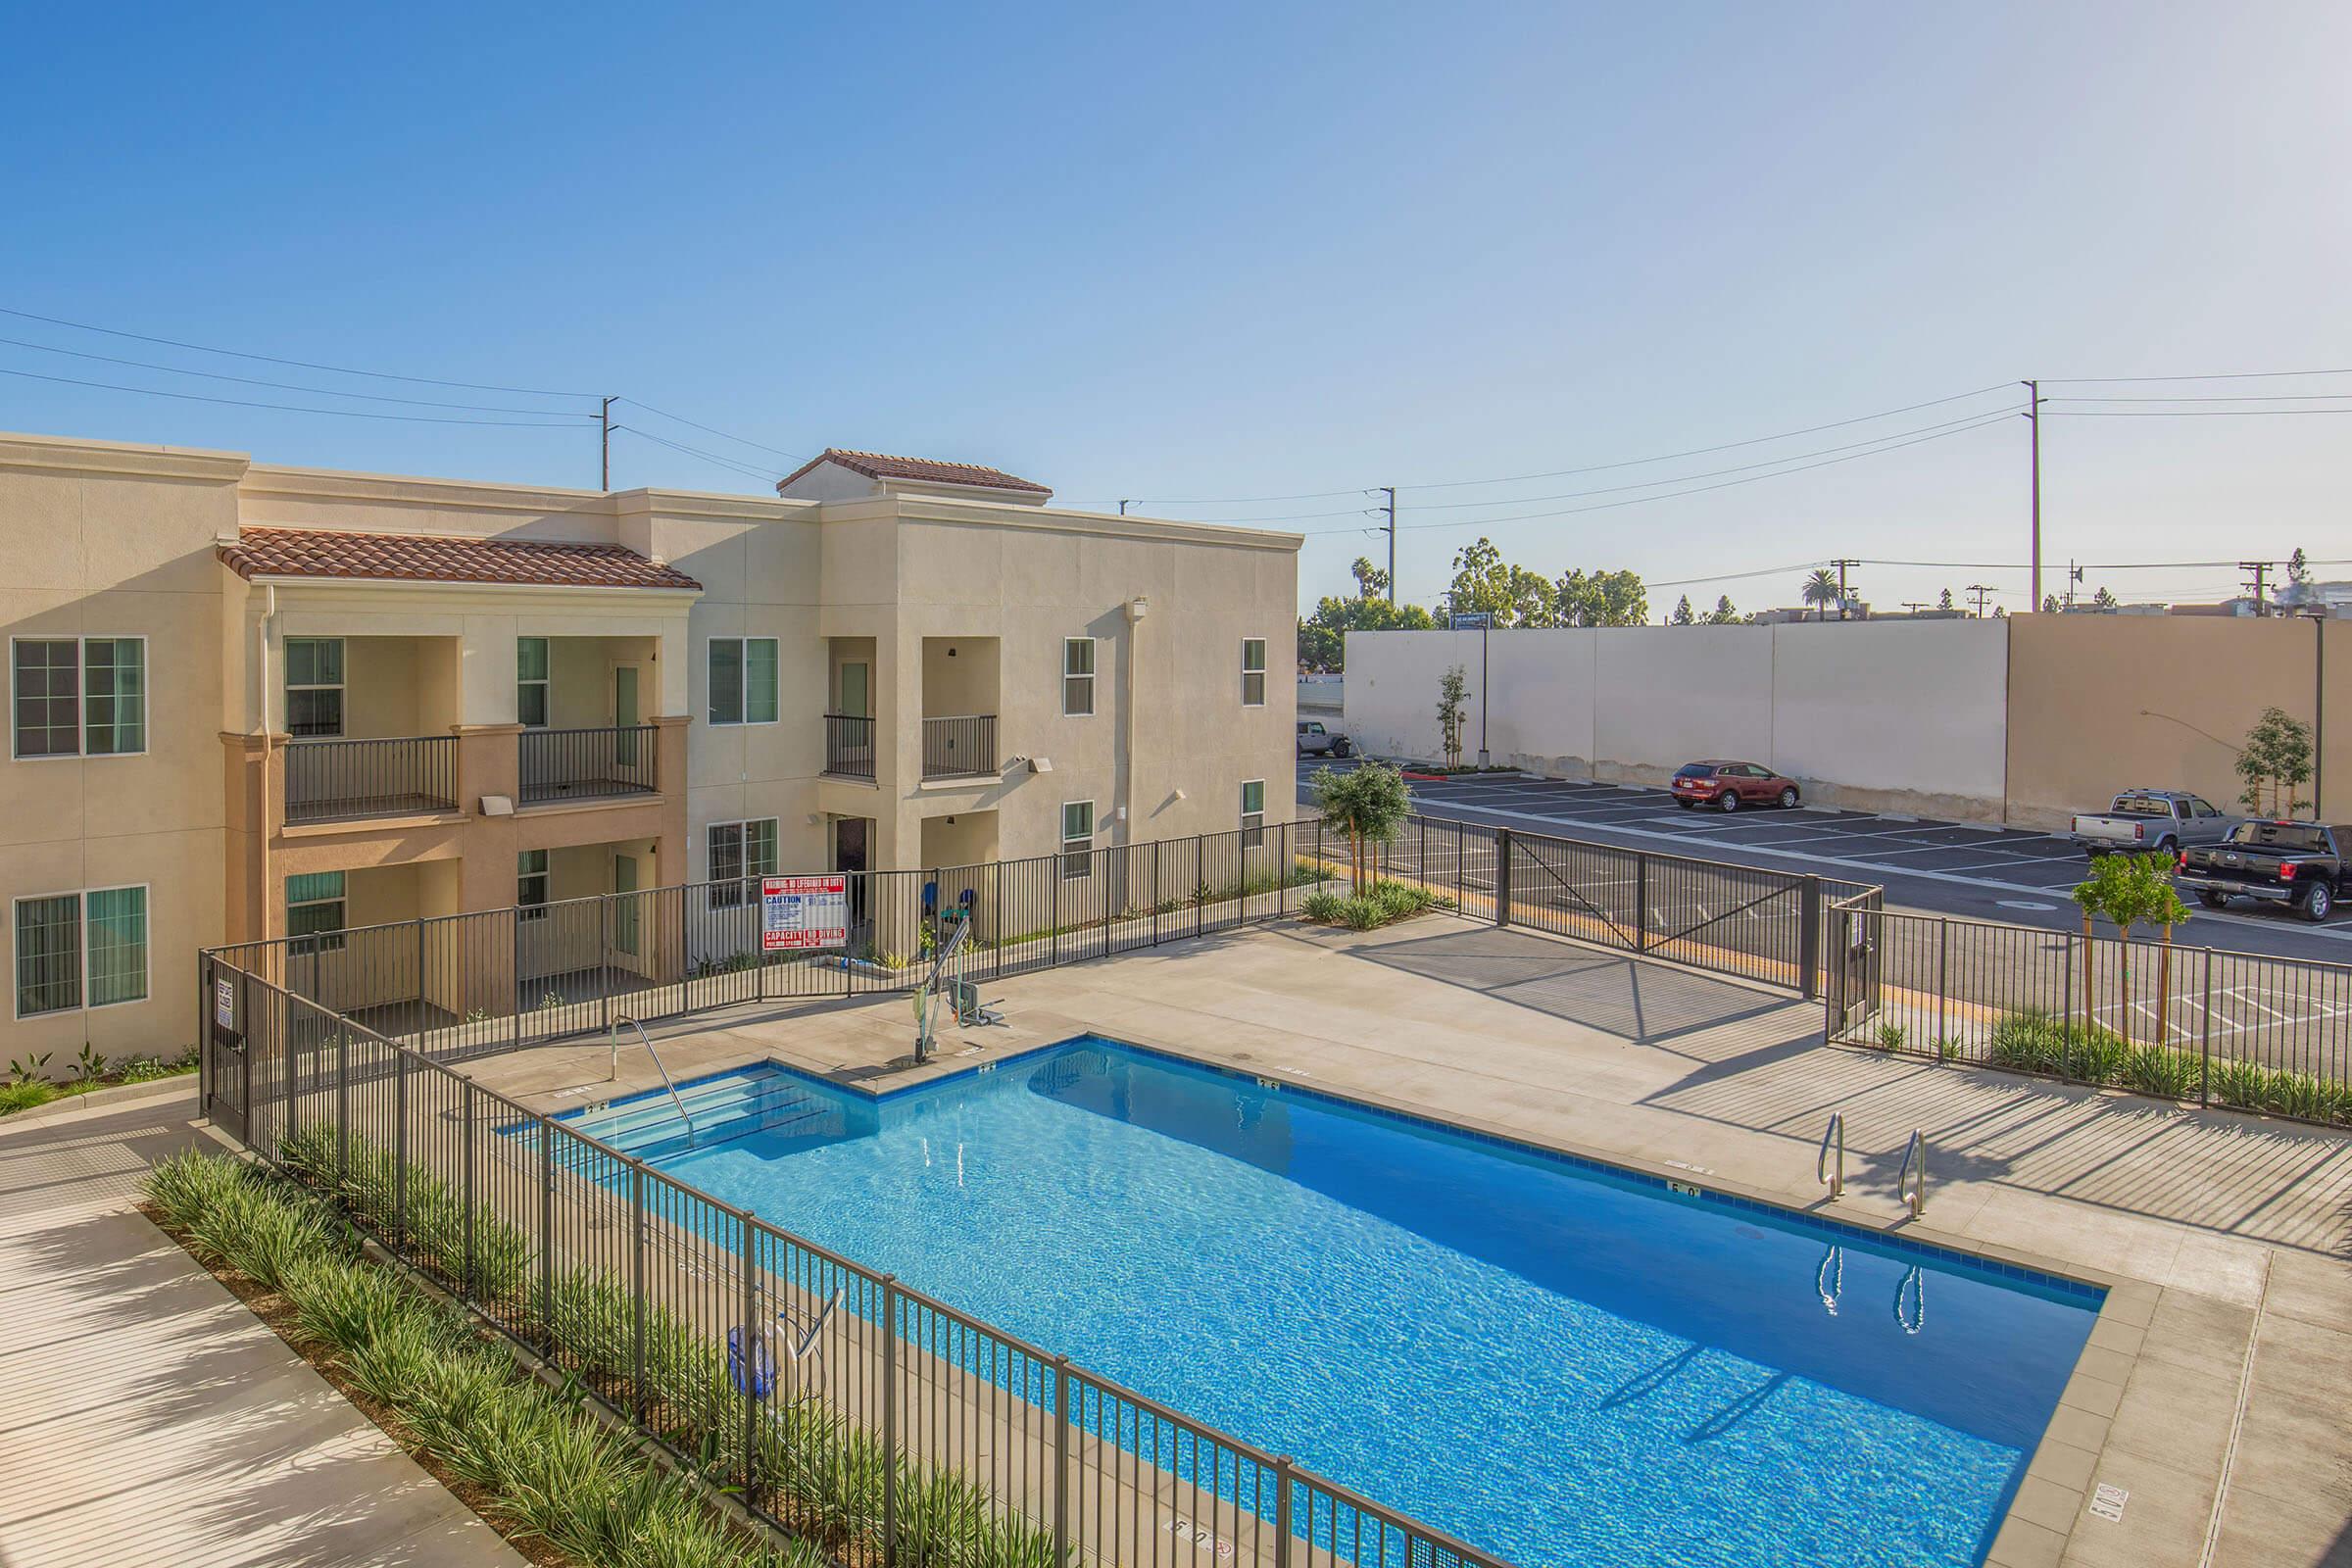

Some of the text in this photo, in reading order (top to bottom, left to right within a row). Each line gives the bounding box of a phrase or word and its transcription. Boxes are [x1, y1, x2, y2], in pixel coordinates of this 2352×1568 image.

[765, 896, 802, 905] CAUTION
[765, 931, 803, 941] CAPACITY
[818, 929, 843, 939] DIVING
